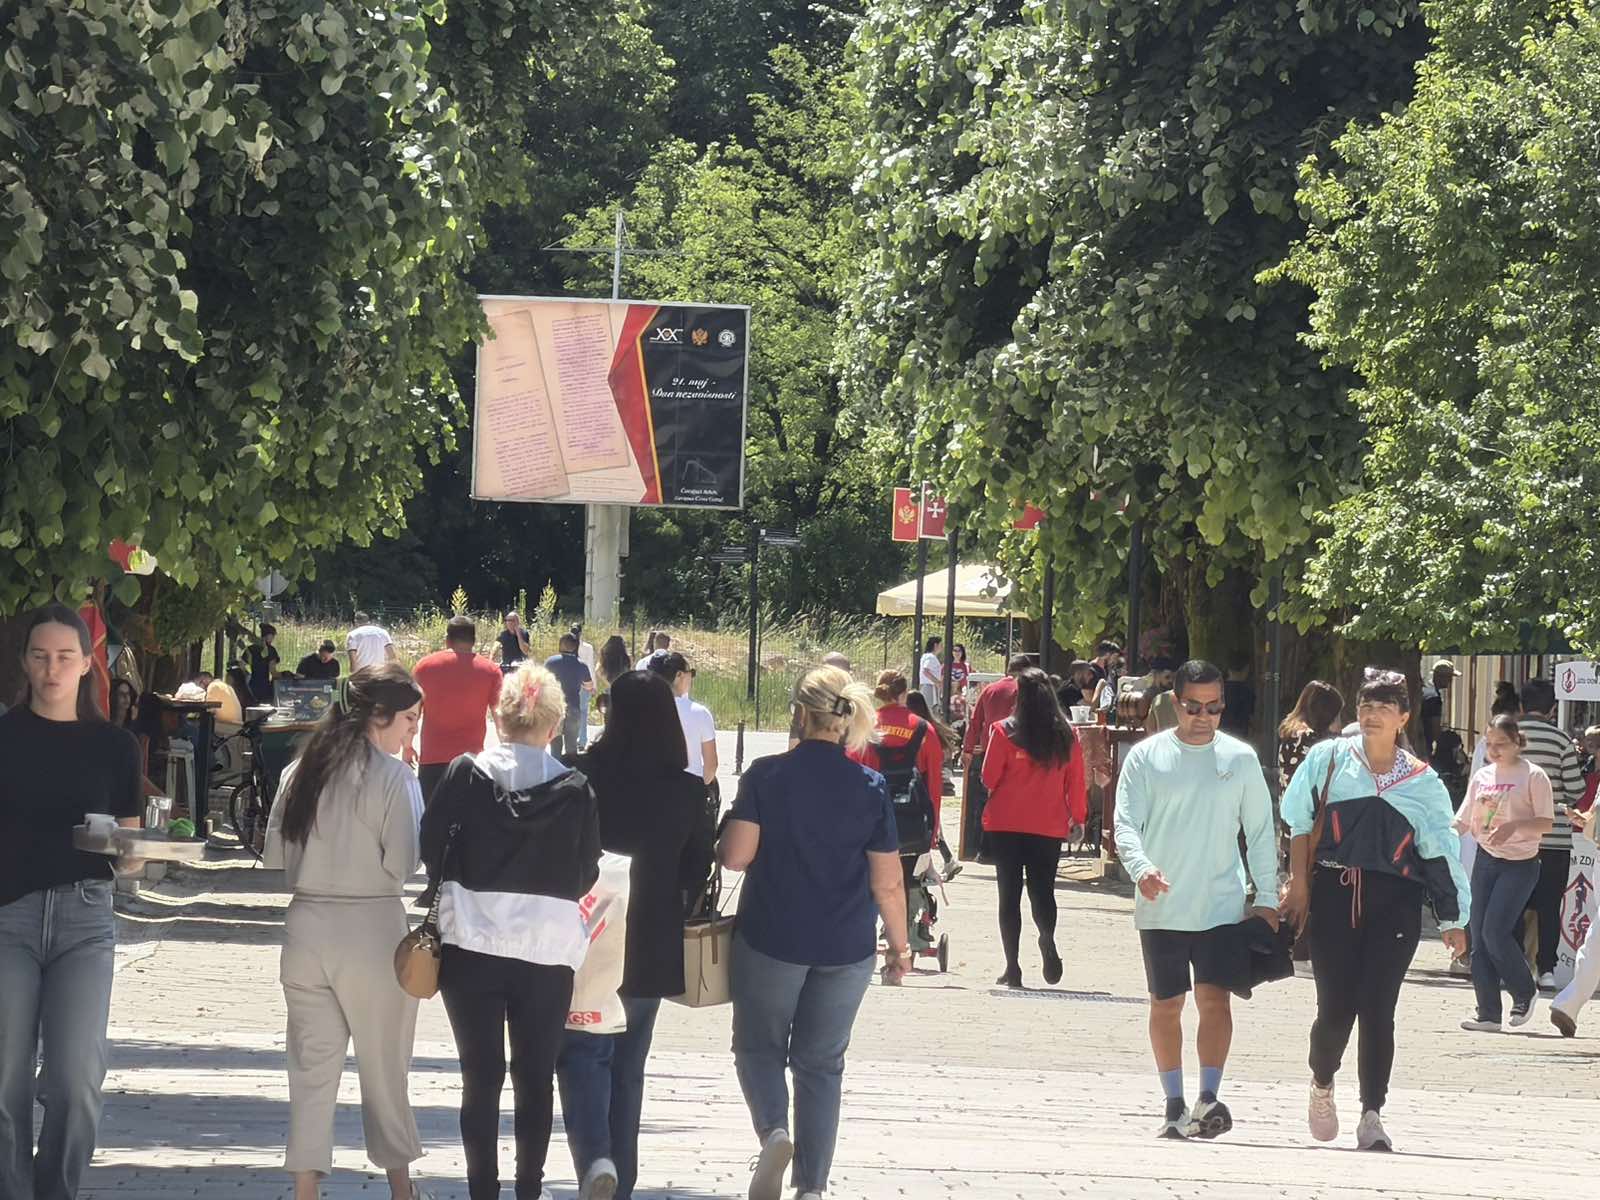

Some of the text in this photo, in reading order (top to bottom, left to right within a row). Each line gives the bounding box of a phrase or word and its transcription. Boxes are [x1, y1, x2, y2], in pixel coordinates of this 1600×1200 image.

[671, 377, 685, 386] 21.
[688, 377, 709, 389] maj
[1560, 952, 1576, 968] CET
